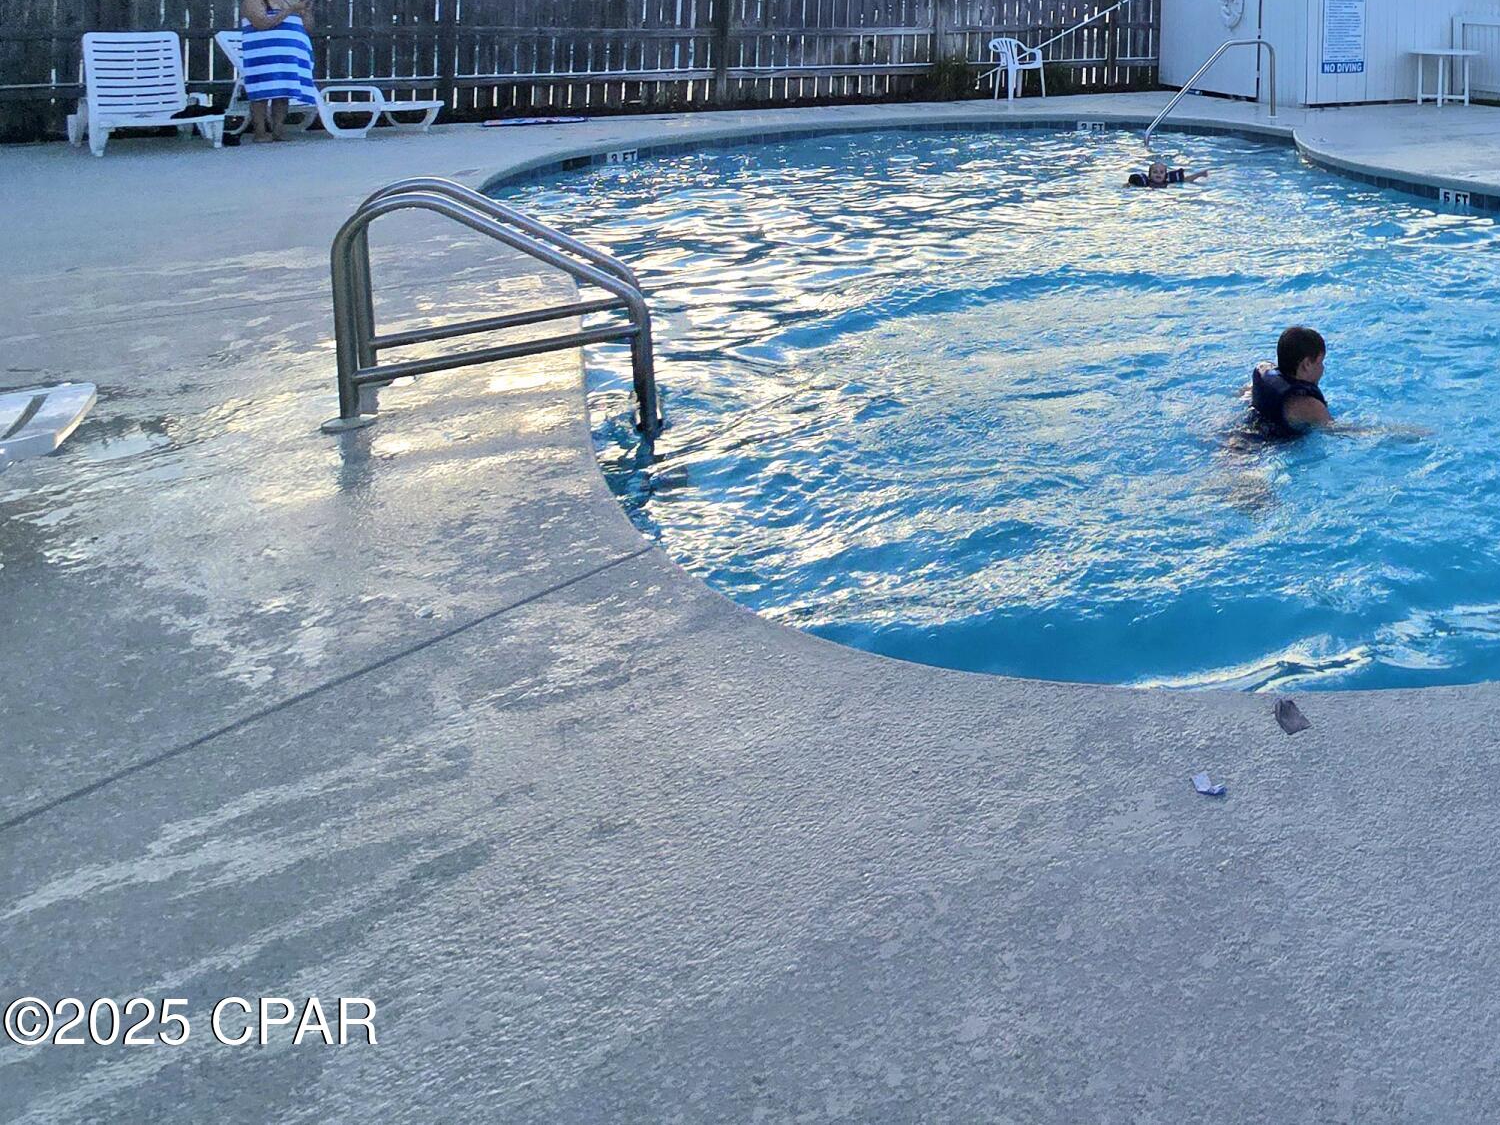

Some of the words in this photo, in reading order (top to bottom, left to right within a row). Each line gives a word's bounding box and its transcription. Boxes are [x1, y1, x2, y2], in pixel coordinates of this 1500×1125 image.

[1324, 63, 1335, 73] NO
[1336, 62, 1363, 73] DIVING
[622, 150, 637, 162] FT
[1455, 193, 1468, 205] FT
